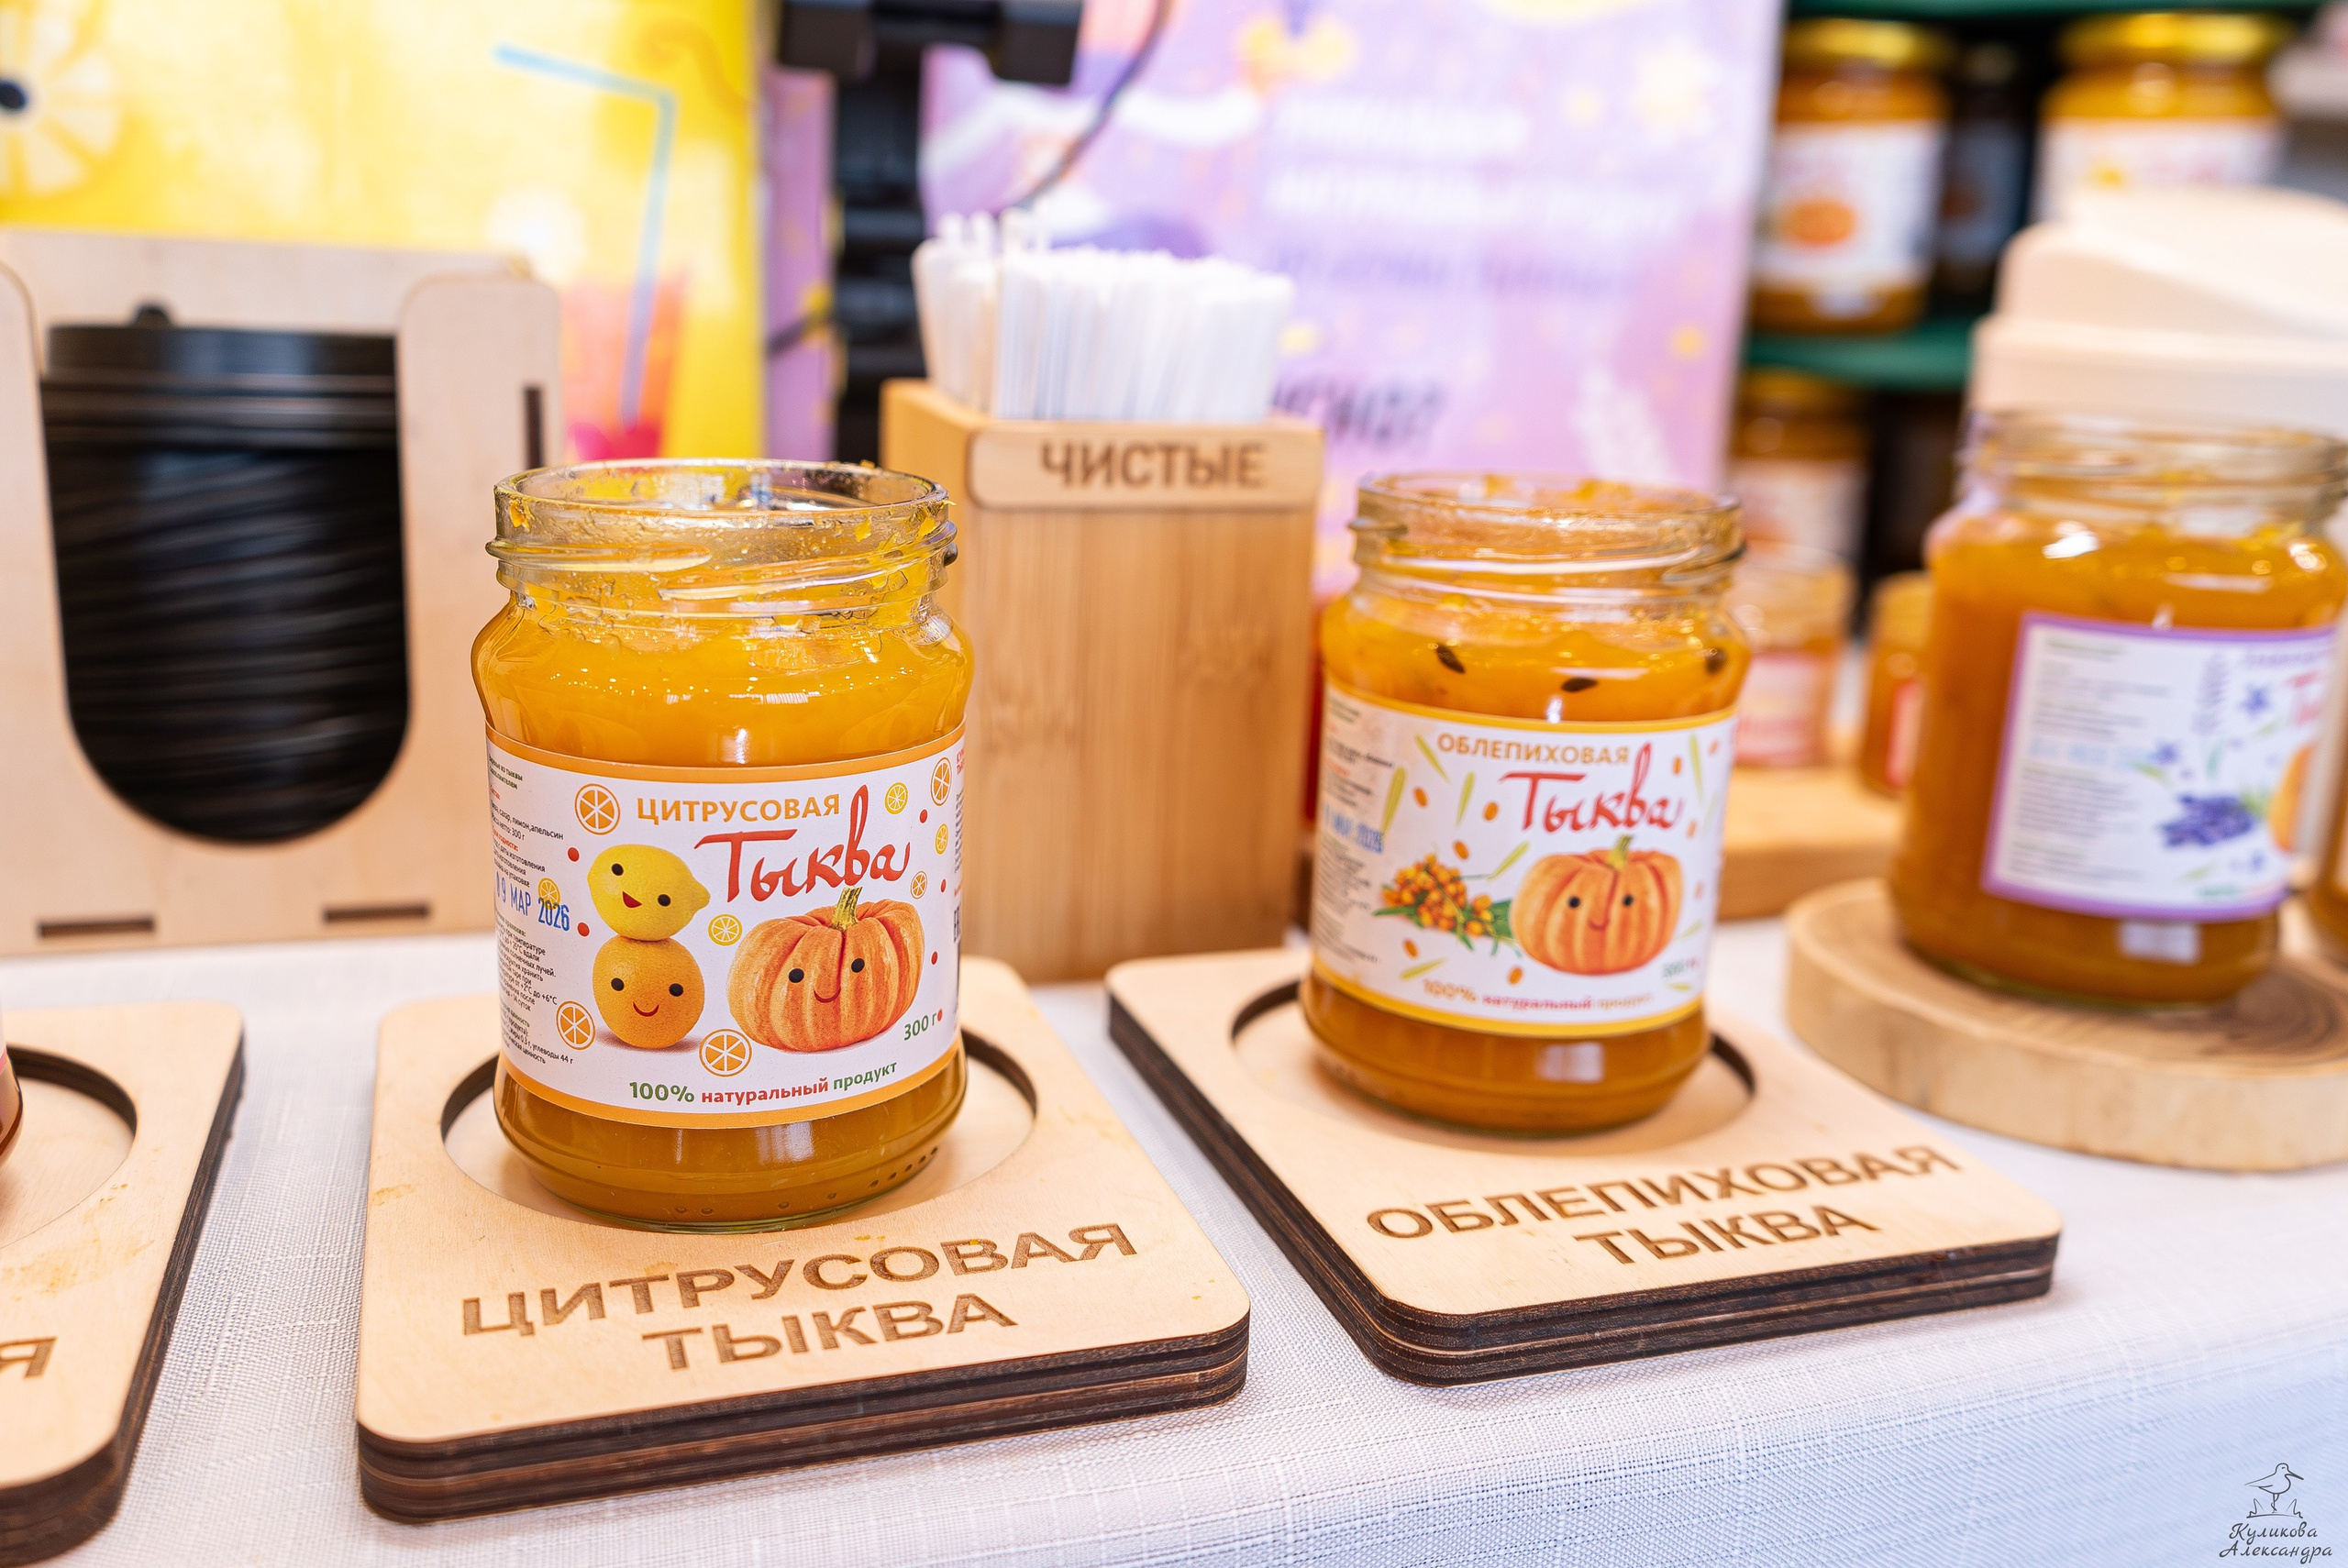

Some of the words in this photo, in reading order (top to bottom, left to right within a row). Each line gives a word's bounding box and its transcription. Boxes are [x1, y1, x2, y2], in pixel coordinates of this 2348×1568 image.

[1040, 440, 1266, 490] ЧИСТЫЕ
[1437, 733, 1630, 765] ОБЛЕПИХОВАЯ
[1500, 742, 1683, 834] Тыква
[637, 794, 839, 825] ЦИТРУСОВАЯ
[512, 827, 522, 839] 300
[693, 785, 911, 903] Тыква
[509, 851, 546, 873] изготовления
[510, 883, 532, 917] МАР
[537, 896, 570, 933] 2026
[514, 933, 546, 956] температуре
[521, 966, 544, 982] хранить
[536, 964, 557, 978] лучей.
[541, 993, 558, 1006] +6°С
[903, 1019, 929, 1041] 300
[931, 1010, 937, 1026] г
[560, 1054, 569, 1063] 44
[629, 1081, 695, 1103] 100%
[701, 1077, 829, 1106] натуральный
[832, 1060, 898, 1092] продукт
[1365, 1143, 1963, 1240] ОБЛЕПИХОВАЯ
[1572, 1203, 1884, 1265] ТЫКВА
[462, 1222, 1138, 1337] ЦИТРУСОВАЯ
[641, 1292, 1018, 1370] ТЫКВА
